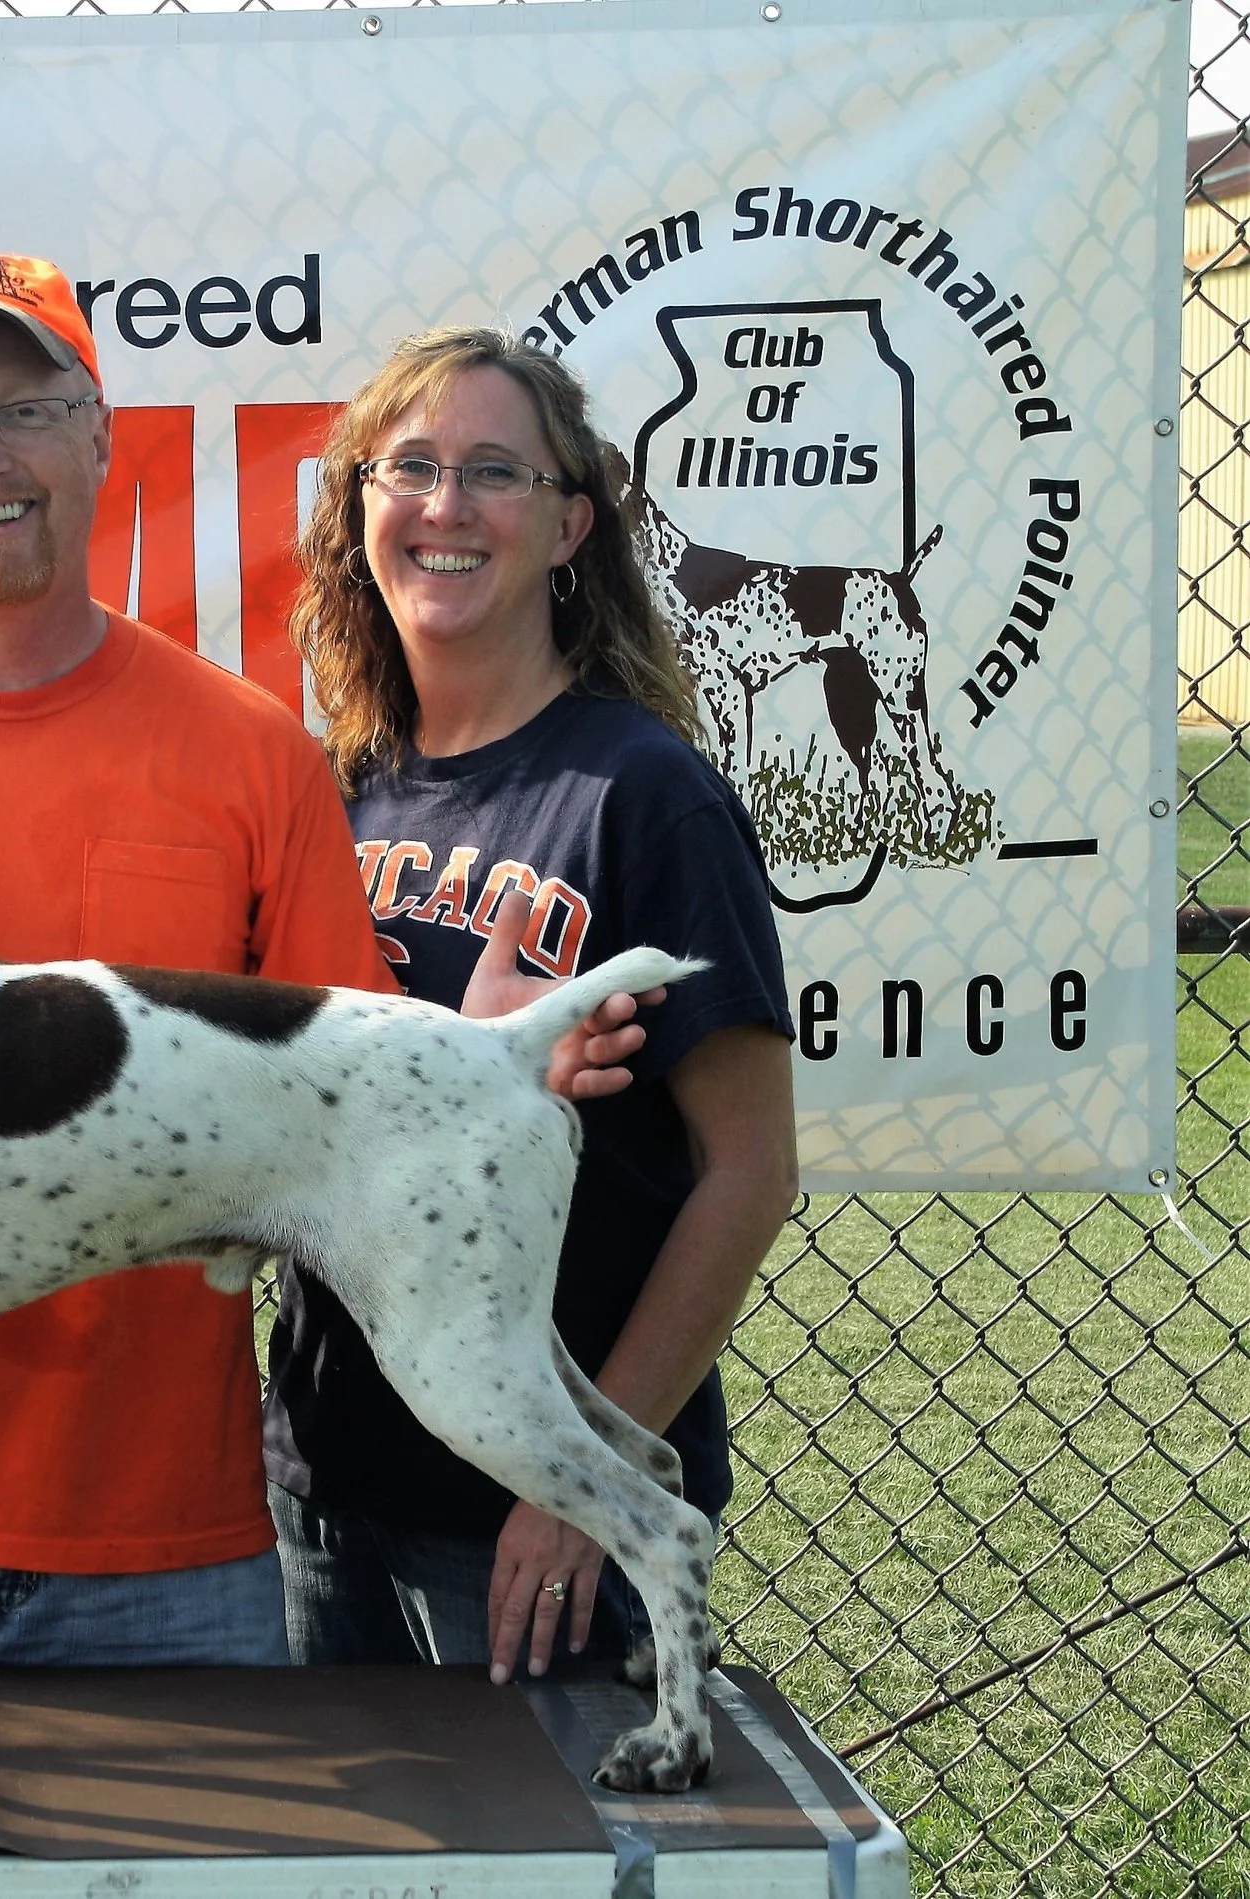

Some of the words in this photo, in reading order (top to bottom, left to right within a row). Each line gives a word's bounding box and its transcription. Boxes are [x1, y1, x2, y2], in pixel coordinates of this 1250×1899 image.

[77, 253, 323, 350] reed
[724, 326, 825, 369] Club
[520, 209, 702, 360] erman
[732, 186, 1074, 441] Shorthaired
[958, 477, 1082, 729] Pointer
[676, 433, 879, 488] Illinois
[353, 840, 593, 980] ICAGO
